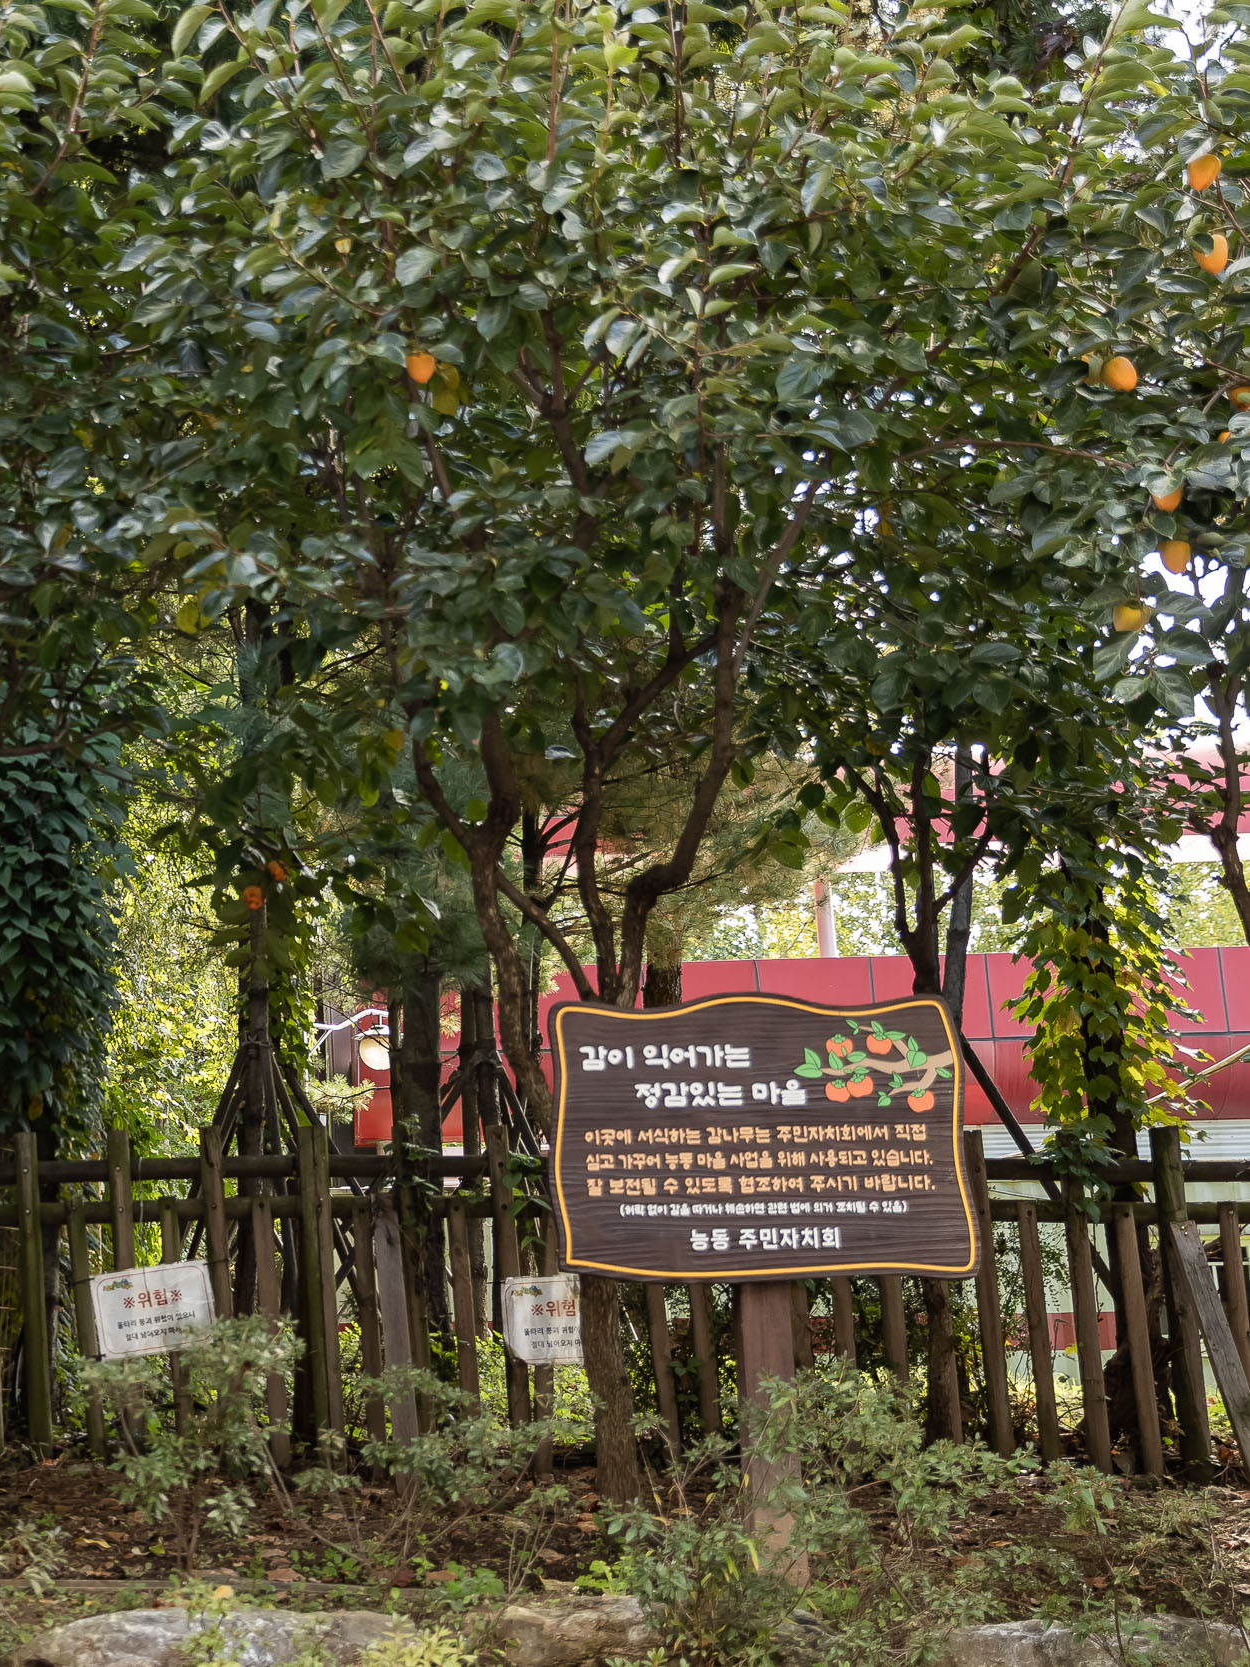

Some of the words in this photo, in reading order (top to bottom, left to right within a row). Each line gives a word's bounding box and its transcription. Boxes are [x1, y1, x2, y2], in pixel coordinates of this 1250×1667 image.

[579, 1045, 635, 1071] 감이
[643, 1044, 751, 1069] 익어가는
[634, 1081, 744, 1109] 정감있는
[751, 1079, 807, 1106] 마을
[584, 1128, 632, 1146] 이곳에
[637, 1127, 701, 1145] 서식하는
[706, 1126, 771, 1145] 감나무는
[776, 1124, 889, 1144] 주민자치회에서
[894, 1123, 927, 1142] 직접
[586, 1153, 615, 1172] 심고
[618, 1152, 661, 1170] 가꾸어
[665, 1152, 693, 1170] 능동
[697, 1151, 726, 1170] 마을
[730, 1150, 773, 1169] 사업을
[777, 1150, 806, 1168] 위해
[810, 1149, 867, 1168] 사용되고
[871, 1149, 934, 1167] 있습니다.
[586, 1178, 603, 1197] 잘
[663, 1177, 679, 1195] 수
[684, 1176, 733, 1195] 있도록
[738, 1175, 803, 1194] 협조하여
[810, 1174, 858, 1193] 주시기
[864, 1173, 936, 1192] 바랍니다.
[647, 1203, 668, 1216] 없이
[670, 1203, 690, 1216] 감을
[692, 1203, 723, 1216] 따거나
[767, 1202, 788, 1215] 관련
[789, 1201, 810, 1214] 법에
[813, 1201, 833, 1214] 의거
[869, 1201, 880, 1213] 수
[690, 1228, 730, 1251] 능동
[738, 1226, 840, 1250] 주민자치회
